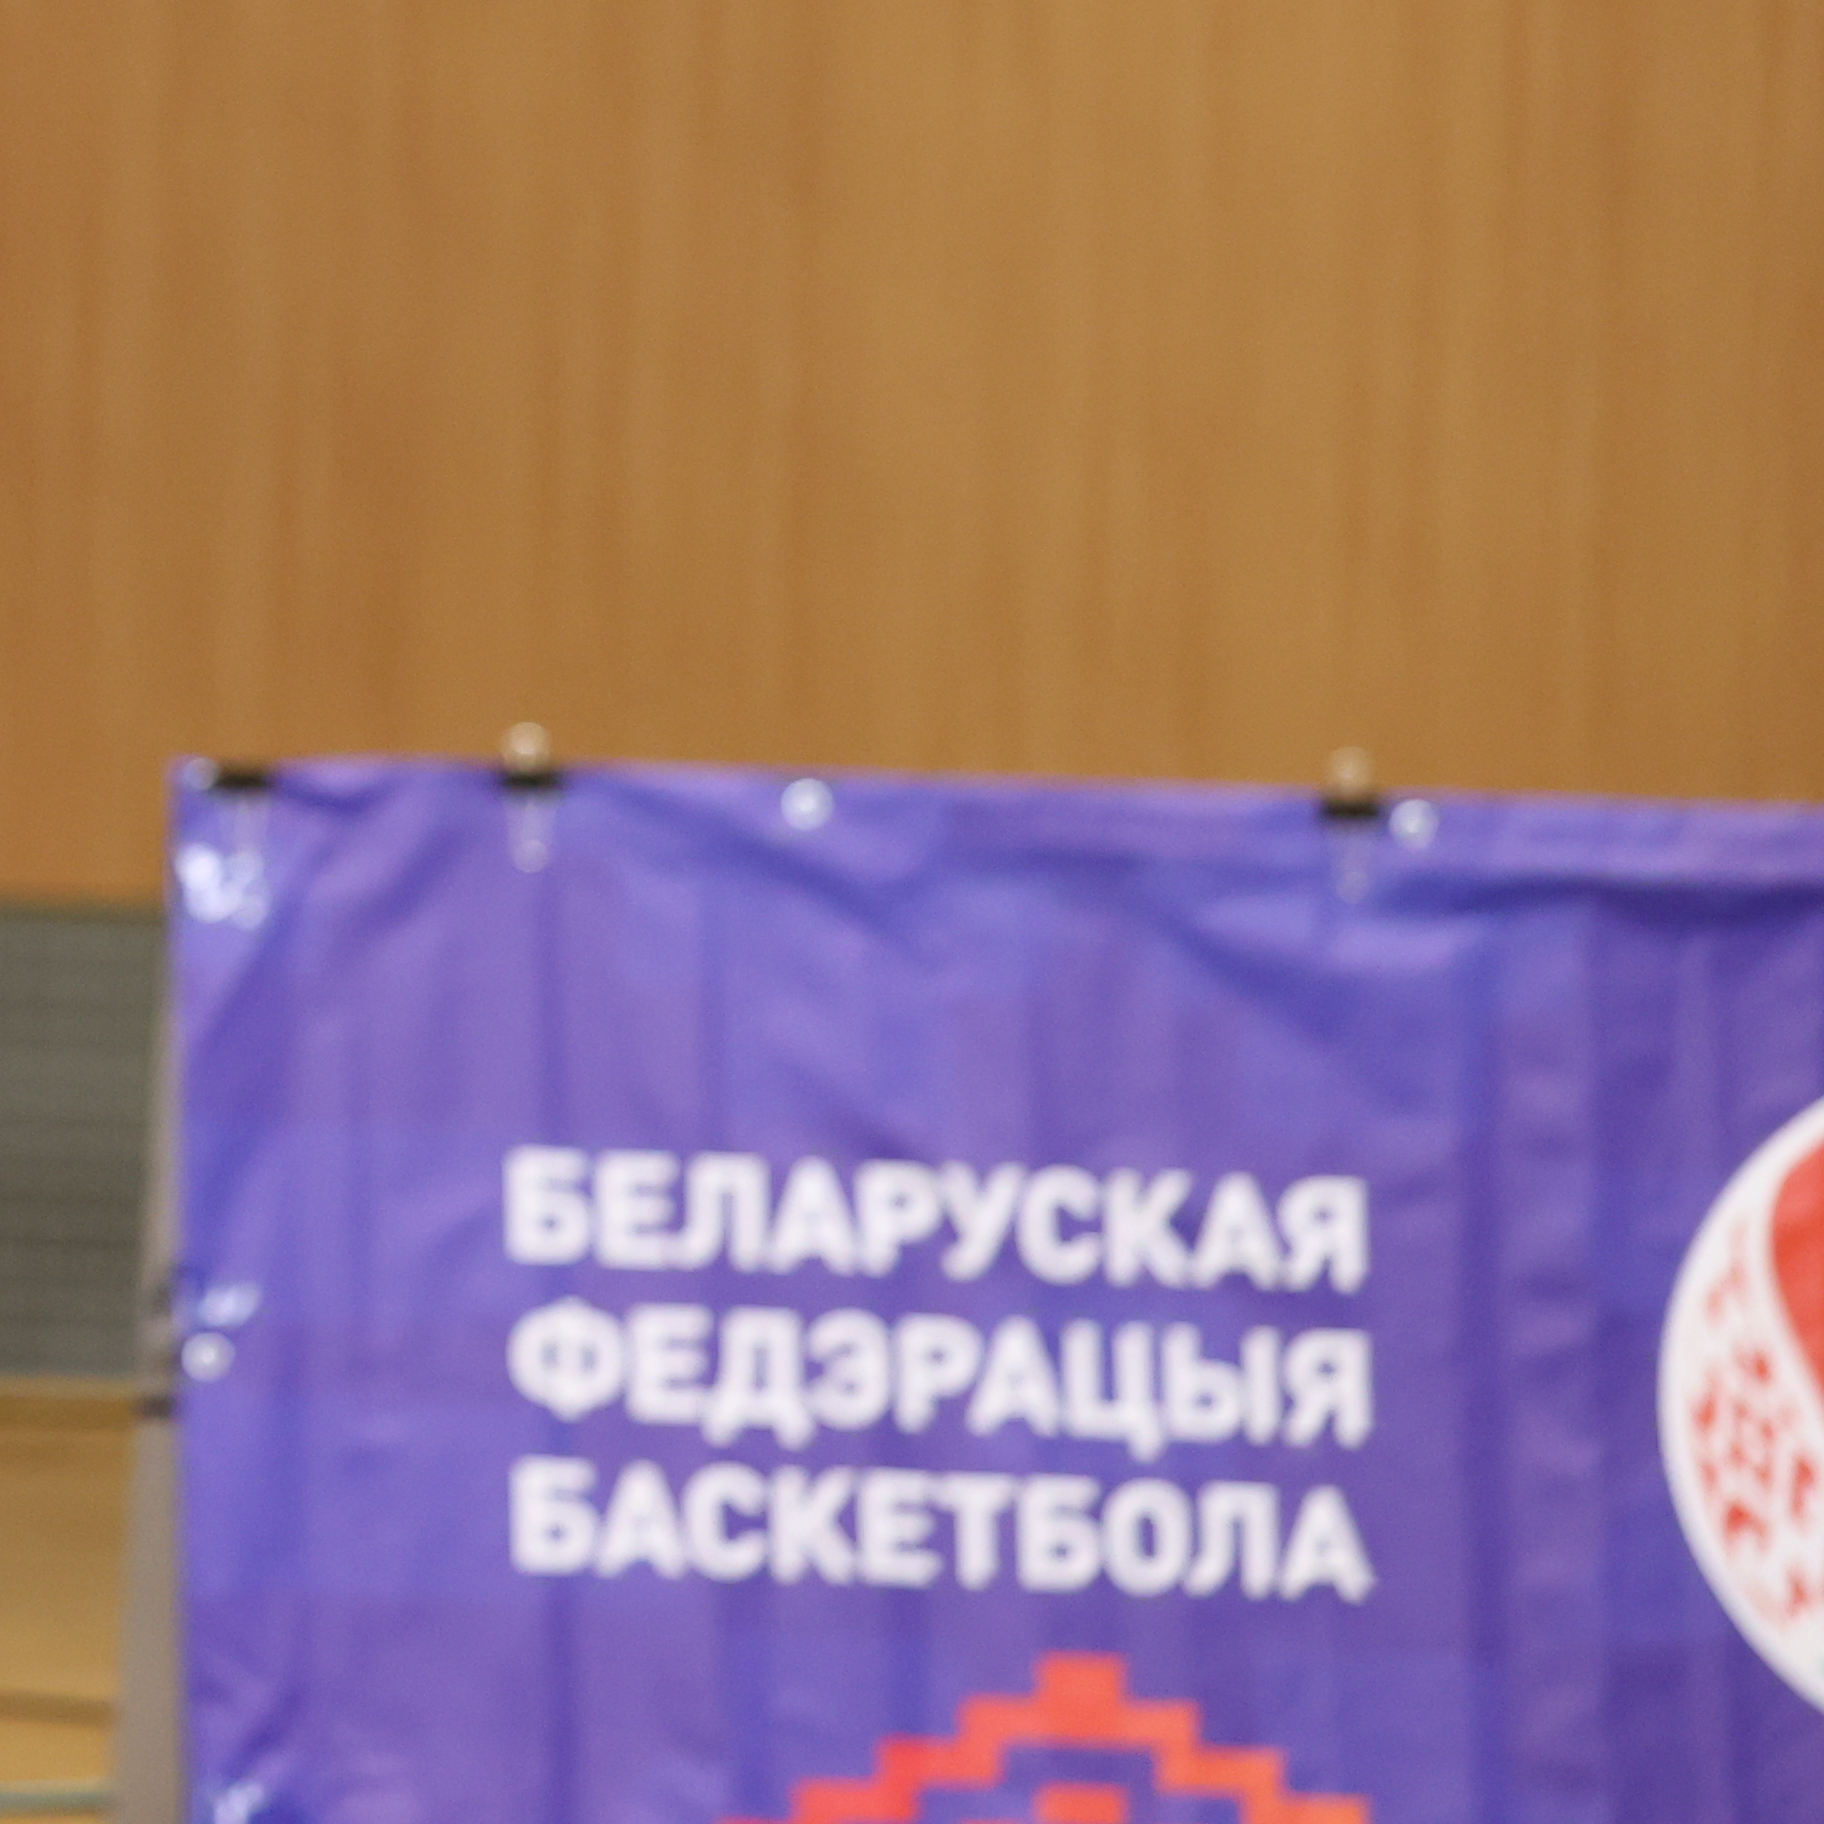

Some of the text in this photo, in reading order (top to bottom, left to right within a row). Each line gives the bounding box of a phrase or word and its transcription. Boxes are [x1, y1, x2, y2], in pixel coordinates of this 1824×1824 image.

[502, 1144, 1368, 1293] БЕЛАРУСКАЯ
[506, 1296, 1373, 1461] ФЕДЭРАЦЫЯ
[509, 1454, 1375, 1603] БАСКЕТБОЛА
